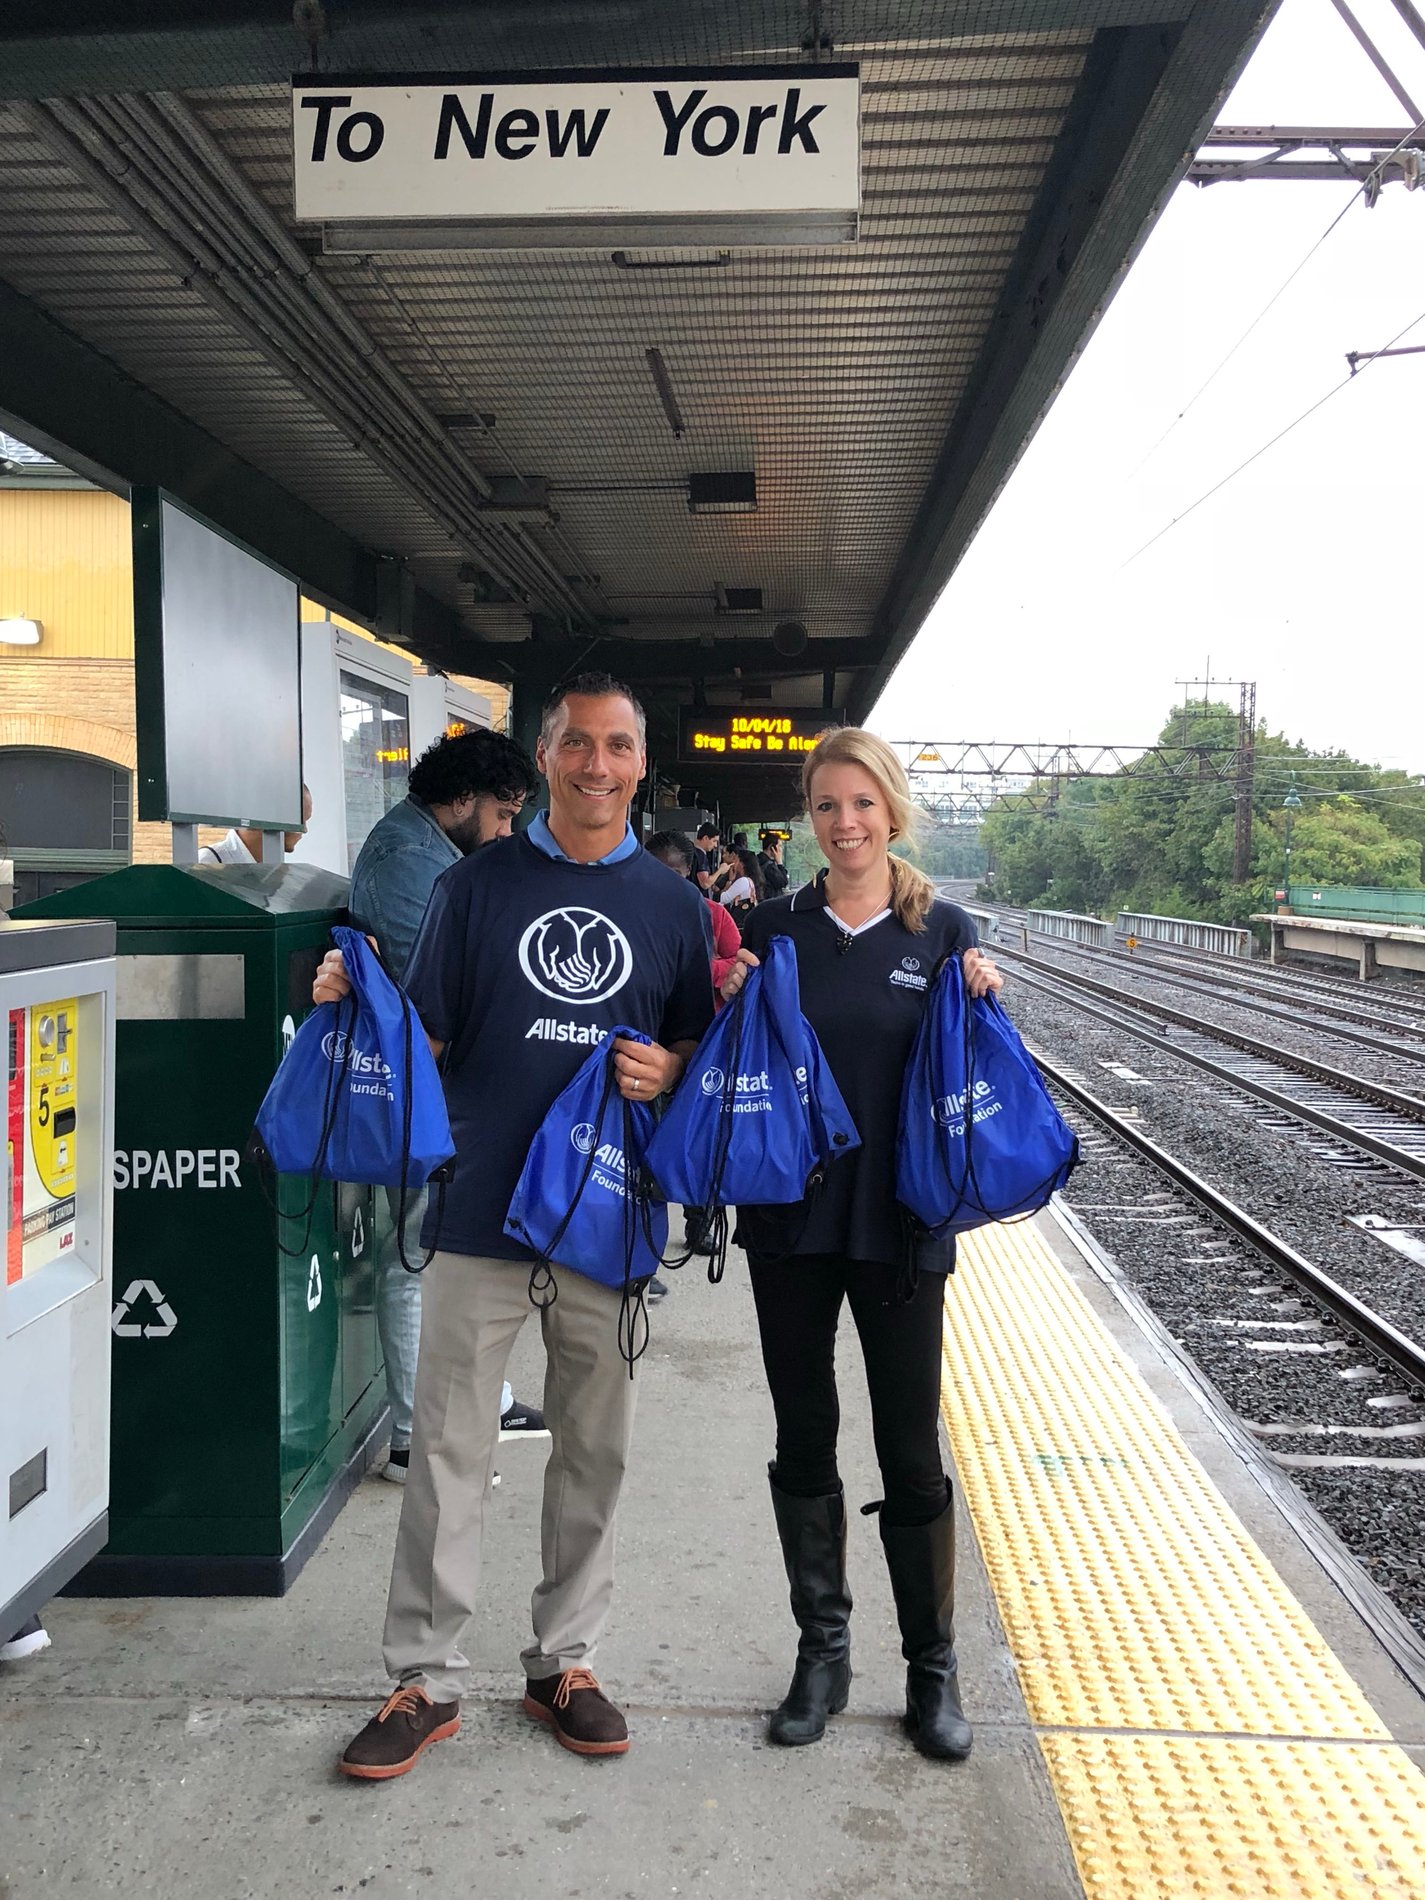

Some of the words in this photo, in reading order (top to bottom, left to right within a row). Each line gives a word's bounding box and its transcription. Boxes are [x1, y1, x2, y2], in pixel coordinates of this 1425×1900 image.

[301, 95, 385, 163] To
[433, 93, 611, 161] New
[652, 87, 828, 157] York
[732, 718, 792, 734] 10/04/18
[694, 733, 726, 752] Stay
[731, 734, 762, 750] Safe
[767, 735, 783, 750] Be
[789, 736, 817, 751] Aler
[38, 1087, 50, 1128] 5
